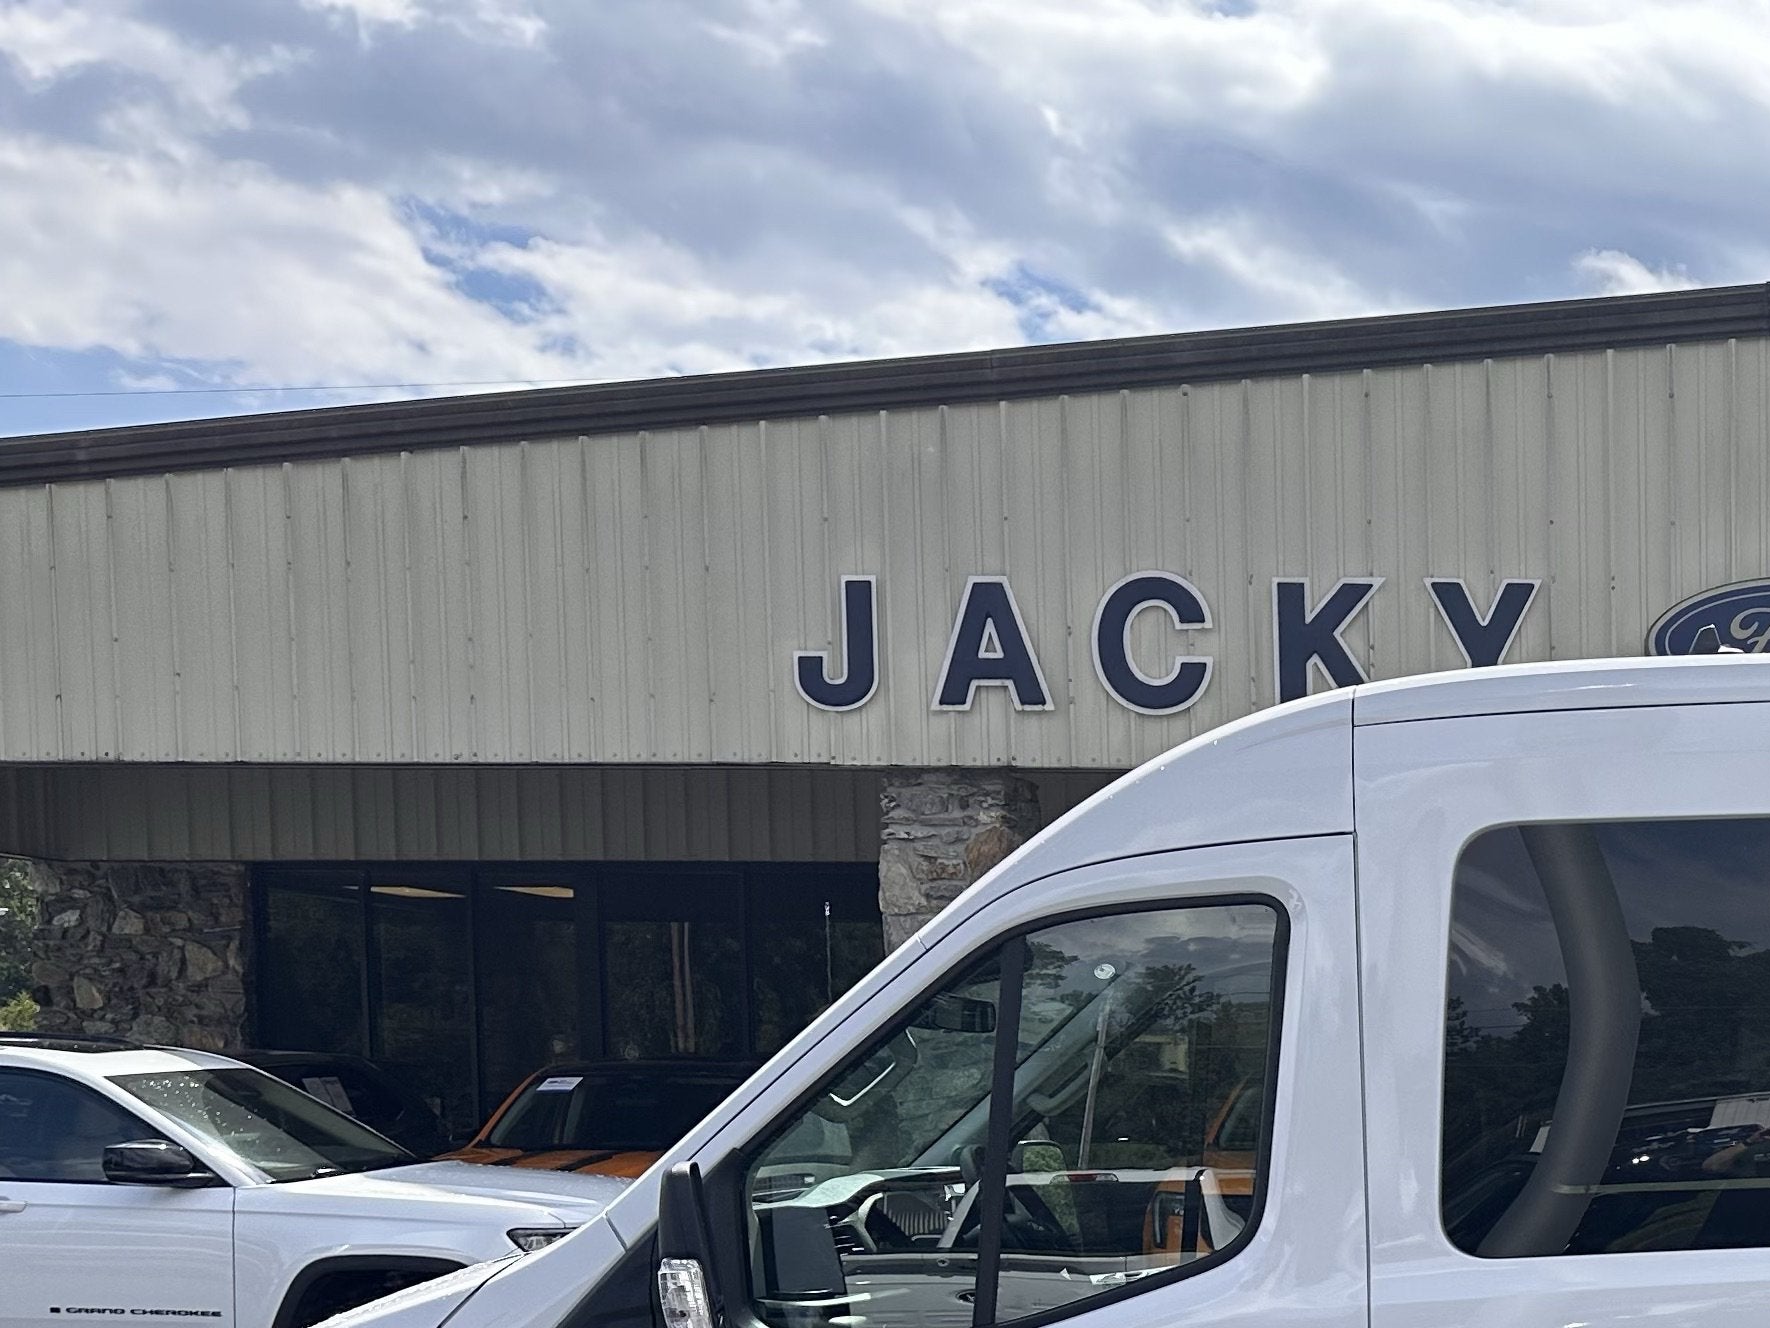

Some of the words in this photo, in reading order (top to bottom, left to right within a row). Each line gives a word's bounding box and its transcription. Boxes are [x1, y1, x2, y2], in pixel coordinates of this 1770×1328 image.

[792, 568, 1543, 716] JACKY
[65, 1306, 126, 1315] GRAND
[129, 1308, 223, 1317] CHEROKEE
